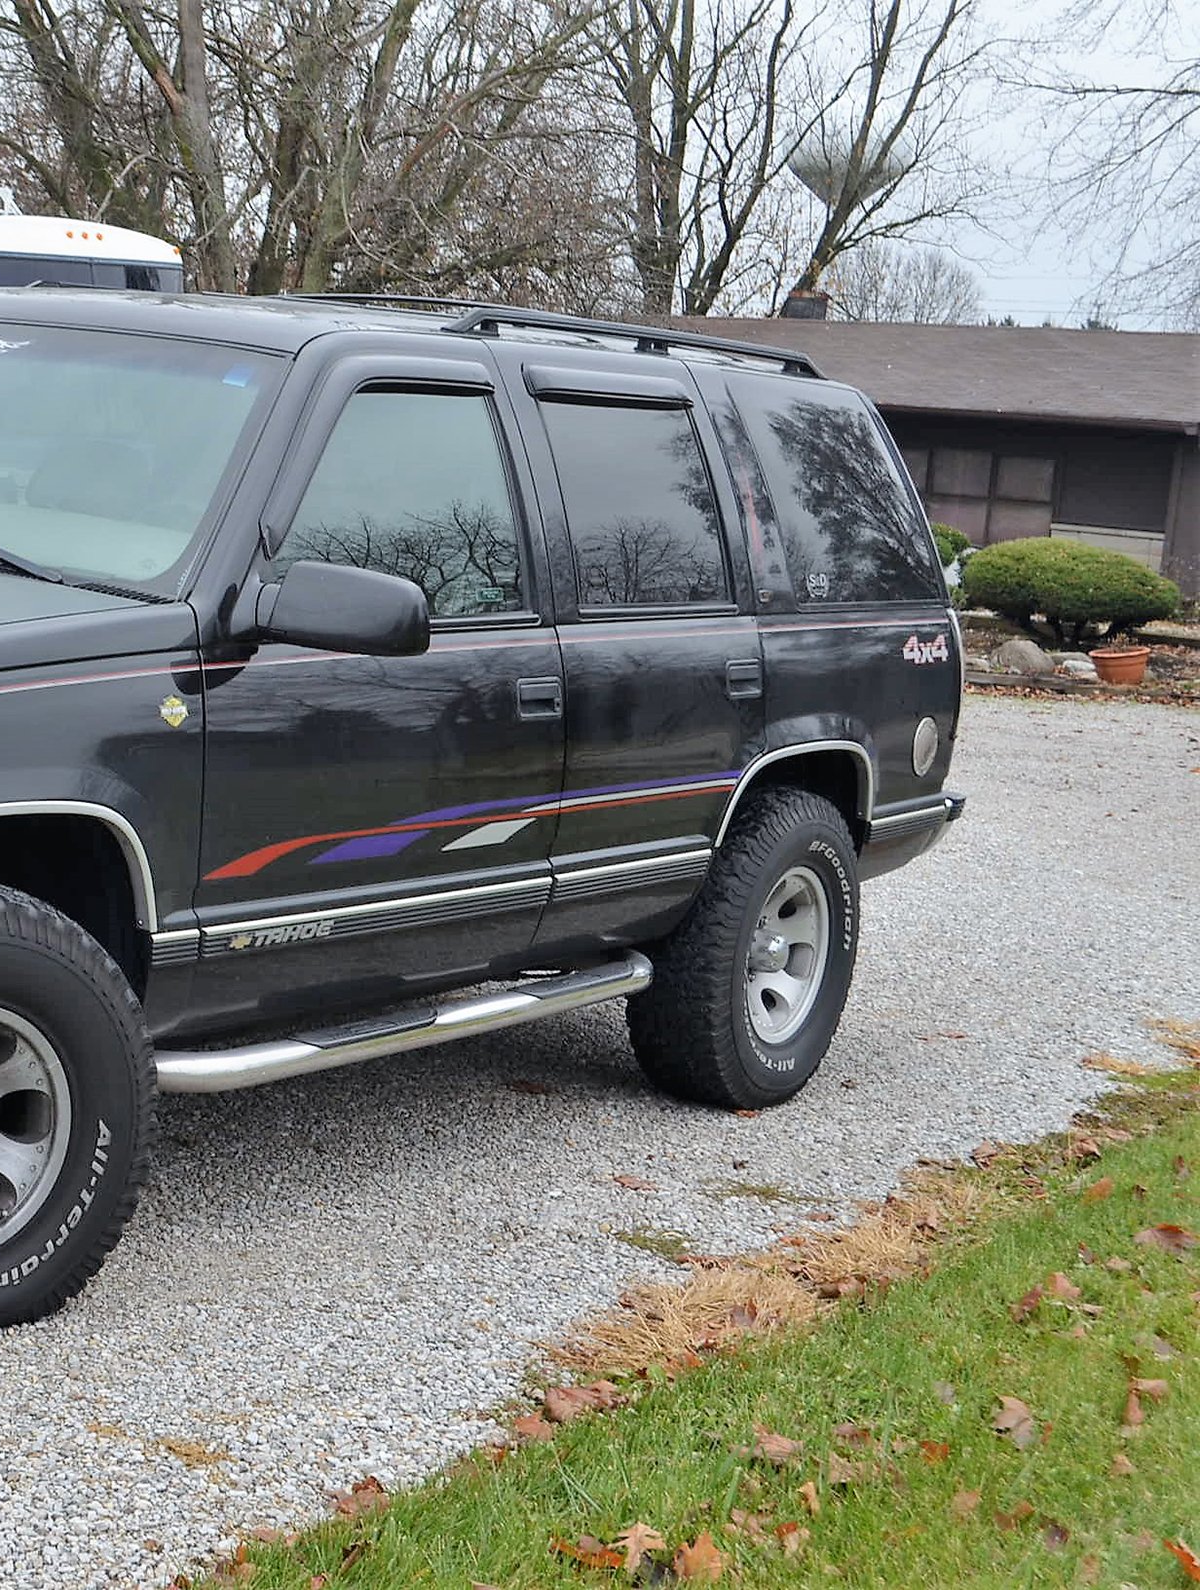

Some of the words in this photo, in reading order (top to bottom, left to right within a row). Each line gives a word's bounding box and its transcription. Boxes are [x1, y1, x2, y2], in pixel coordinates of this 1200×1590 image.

[903, 633, 949, 664] 4x4
[809, 841, 854, 951] BFGoodrich
[254, 920, 335, 947] TAHOE
